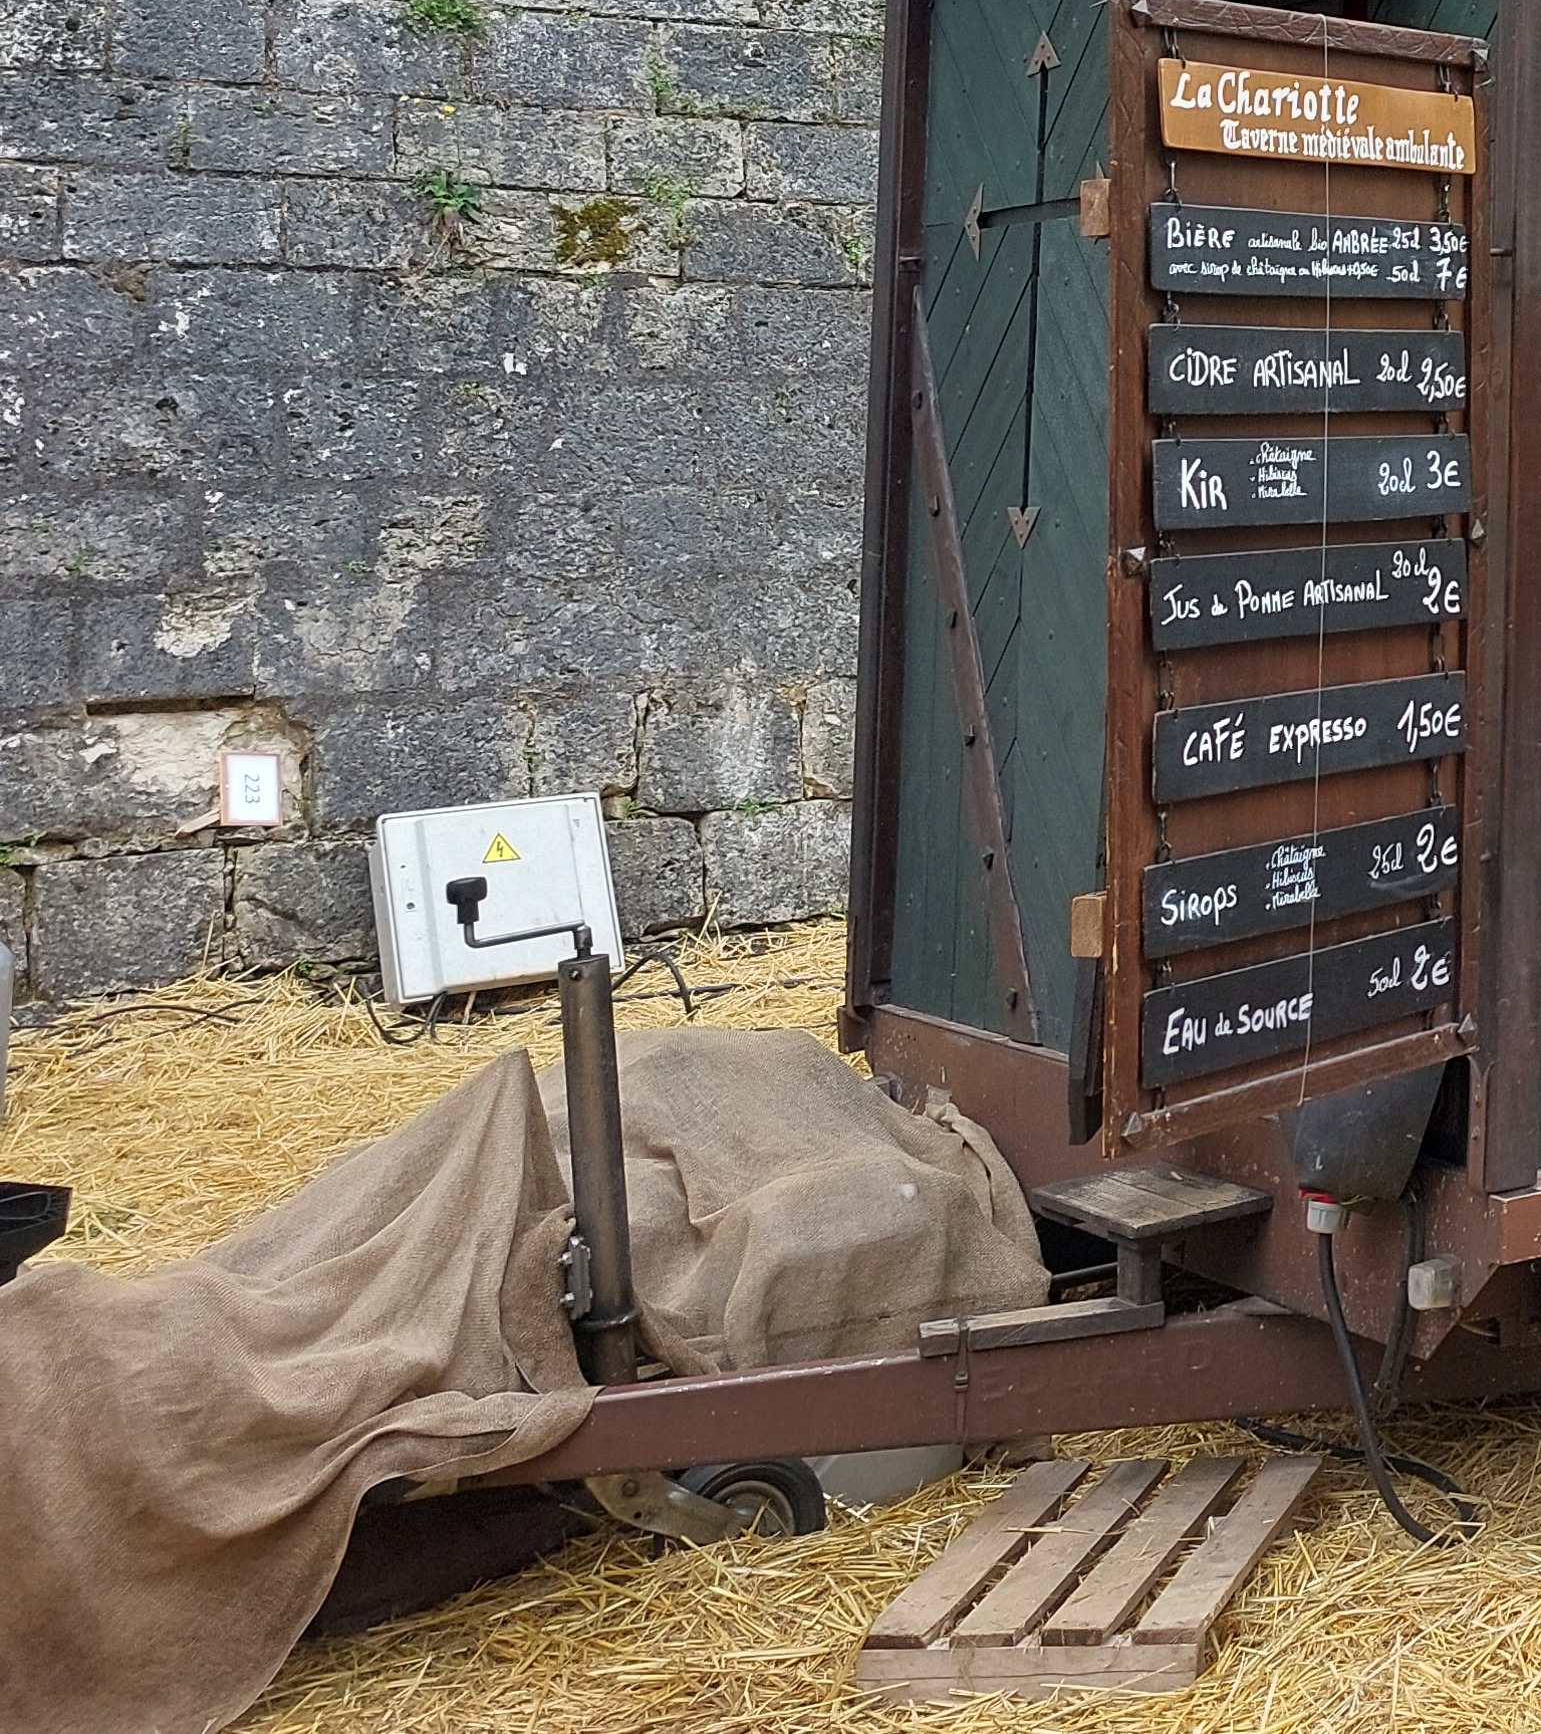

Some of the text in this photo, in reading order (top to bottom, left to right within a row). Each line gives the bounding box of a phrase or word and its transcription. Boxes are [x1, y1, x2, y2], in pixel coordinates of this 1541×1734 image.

[1170, 70, 1360, 125] La Chariotte
[1219, 118, 1300, 154] Taverne
[1385, 129, 1465, 170] ambulante
[1307, 227, 1328, 252] bio
[1168, 262, 1199, 275] avec
[1200, 260, 1230, 283] sirop
[1231, 259, 1243, 276] de
[1416, 357, 1467, 404] 2,50€
[1425, 450, 1462, 490] 3€
[1211, 594, 1229, 616] de
[1182, 699, 1462, 766] CAFÉ EXPRESSO 1,50€
[244, 773, 261, 804] 223
[1214, 1011, 1234, 1037] de
[1236, 992, 1314, 1035] SOURCE
